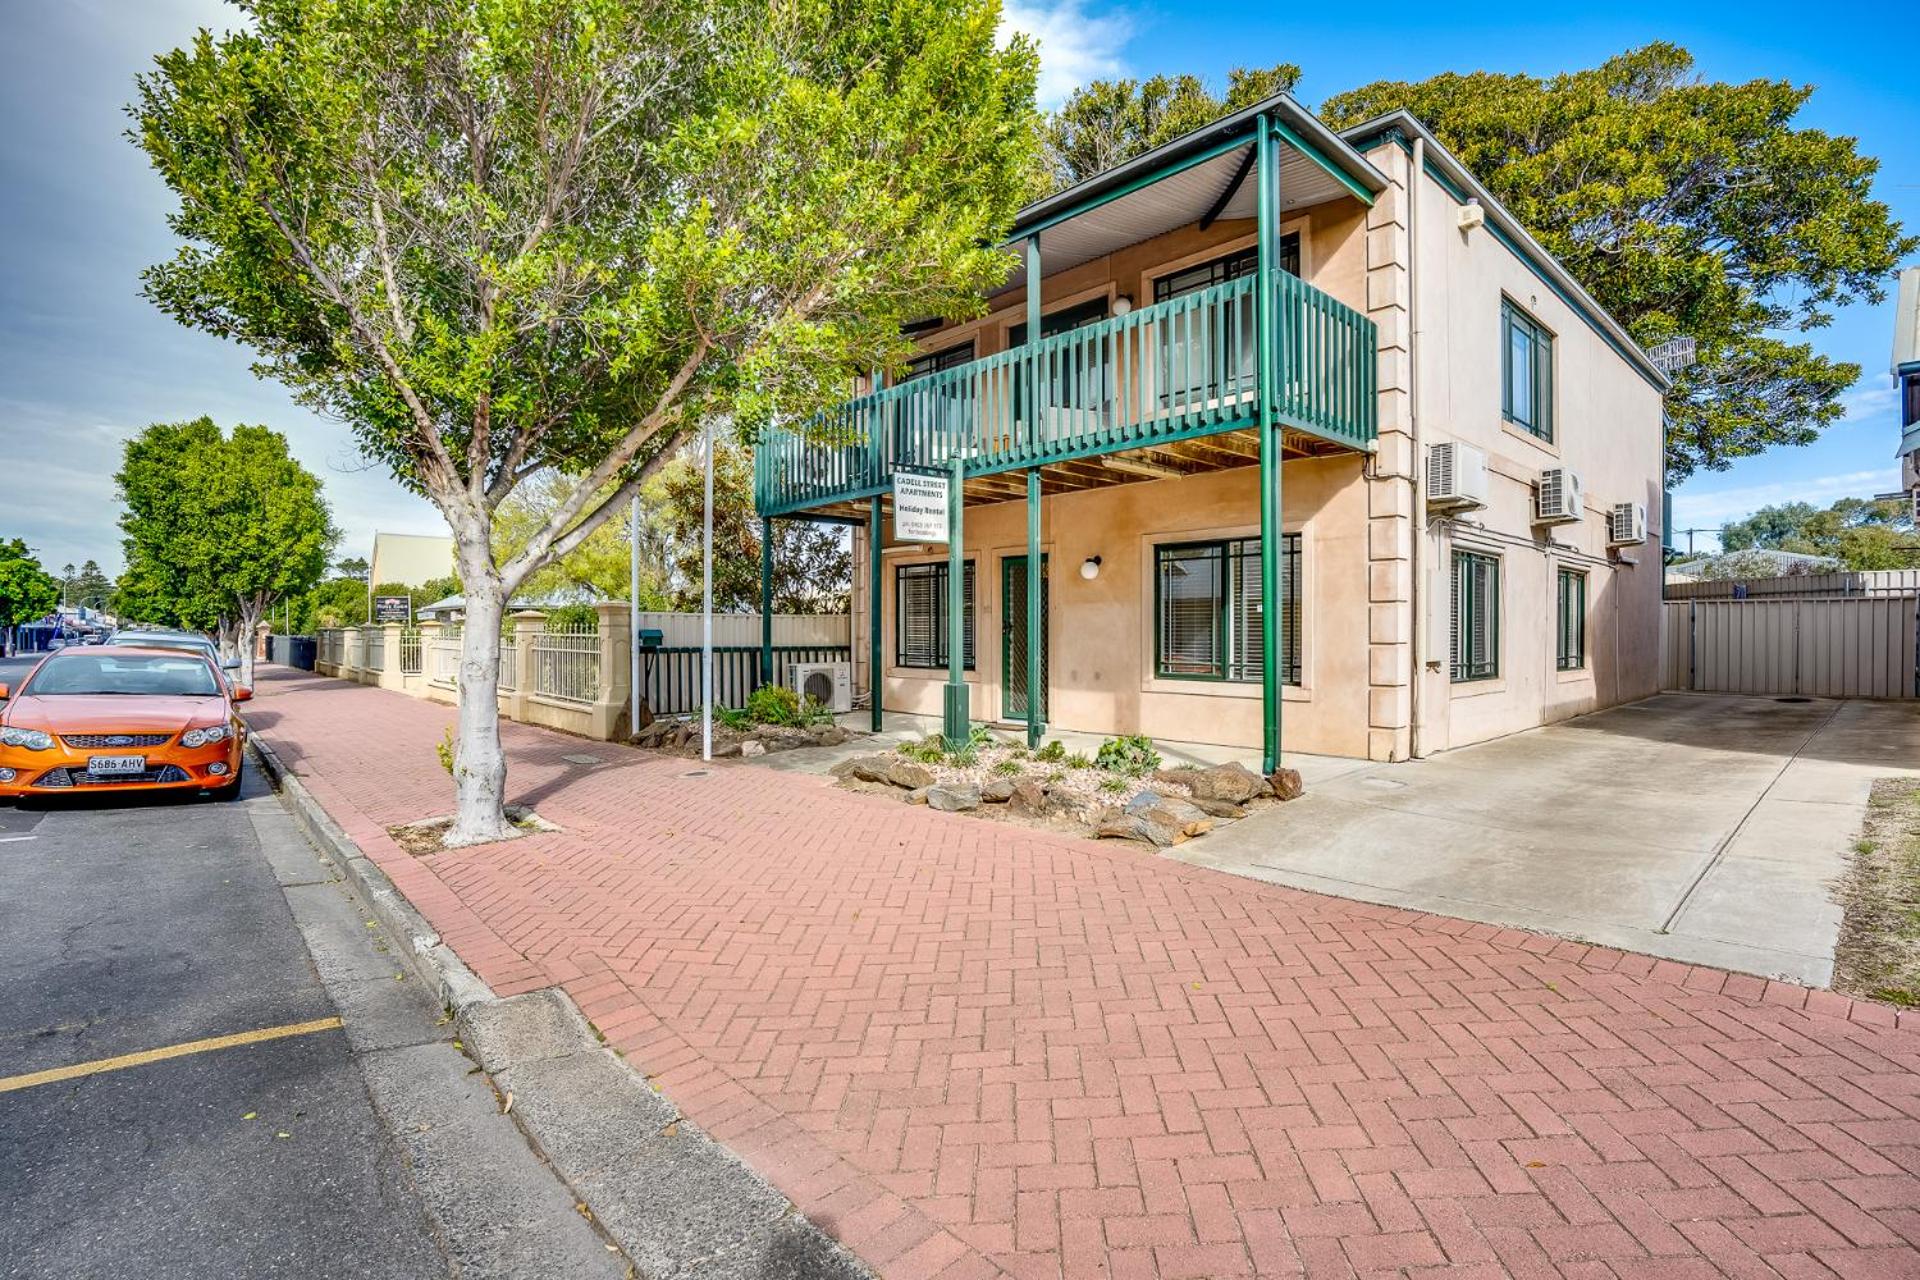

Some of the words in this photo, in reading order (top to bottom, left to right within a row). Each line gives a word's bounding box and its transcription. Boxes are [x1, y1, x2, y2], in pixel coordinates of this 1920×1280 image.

[897, 477, 922, 487] CADELL
[922, 480, 946, 489] STREET
[900, 488, 943, 498] APARTMENTS
[899, 504, 923, 515] Holiday
[924, 507, 945, 516] Rental
